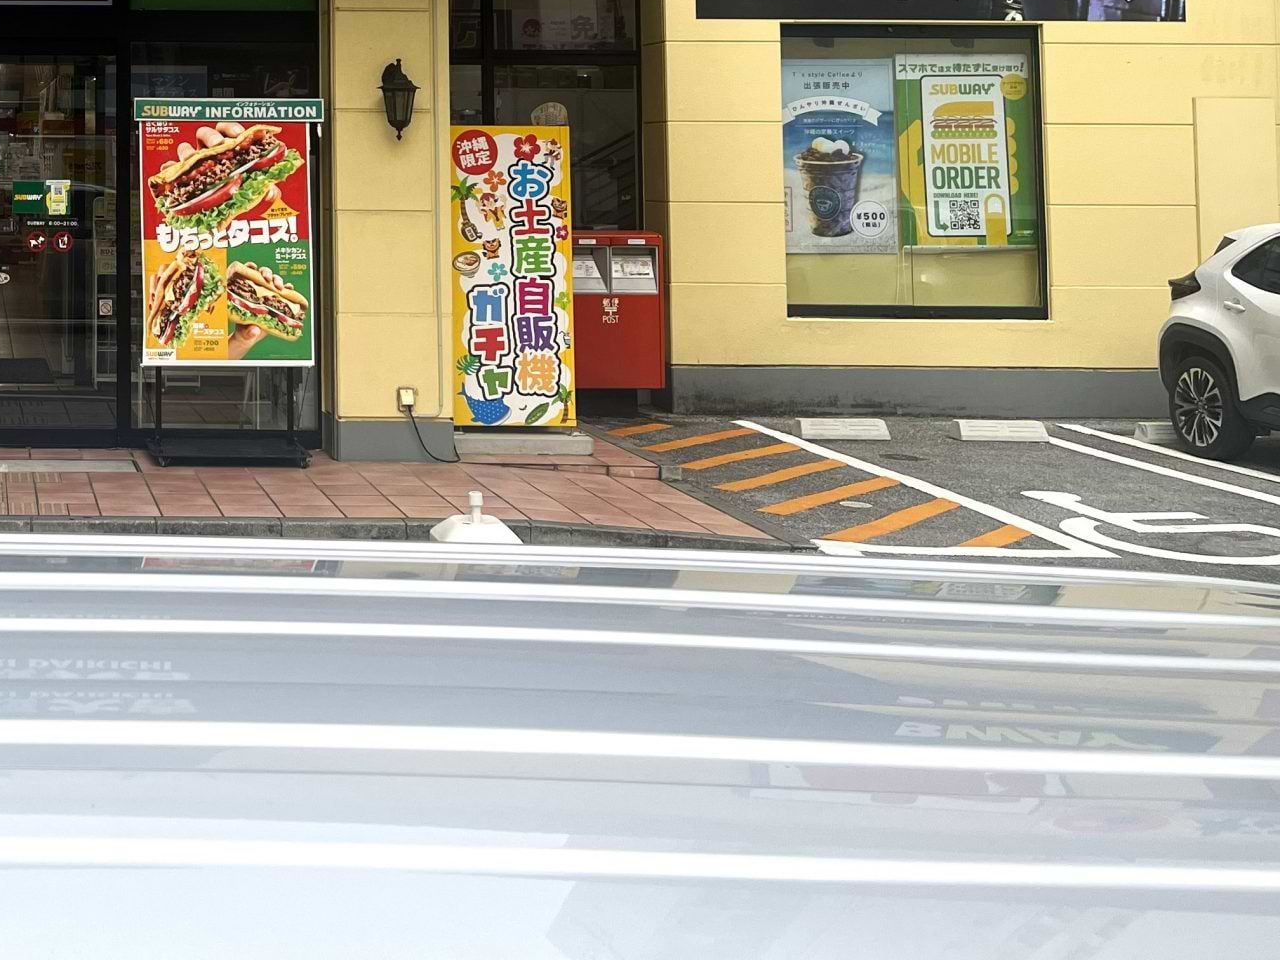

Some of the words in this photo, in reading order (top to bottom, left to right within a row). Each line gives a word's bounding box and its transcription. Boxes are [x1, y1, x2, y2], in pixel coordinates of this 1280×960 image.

[803, 81, 850, 90] 出張販売中
[929, 82, 995, 96] SUBWAY
[142, 105, 202, 118] SUBWAY
[205, 105, 317, 119] INFORMATION
[456, 135, 490, 155] 沖縄
[459, 151, 492, 169] 限定
[930, 143, 999, 165] MOBILE
[932, 166, 1001, 190] ORDER
[13, 193, 43, 201] SUBWAY
[856, 212, 886, 220] ¥500
[509, 161, 558, 394] お土産自販機
[602, 315, 620, 324] POST
[471, 288, 512, 397] ガチャ
